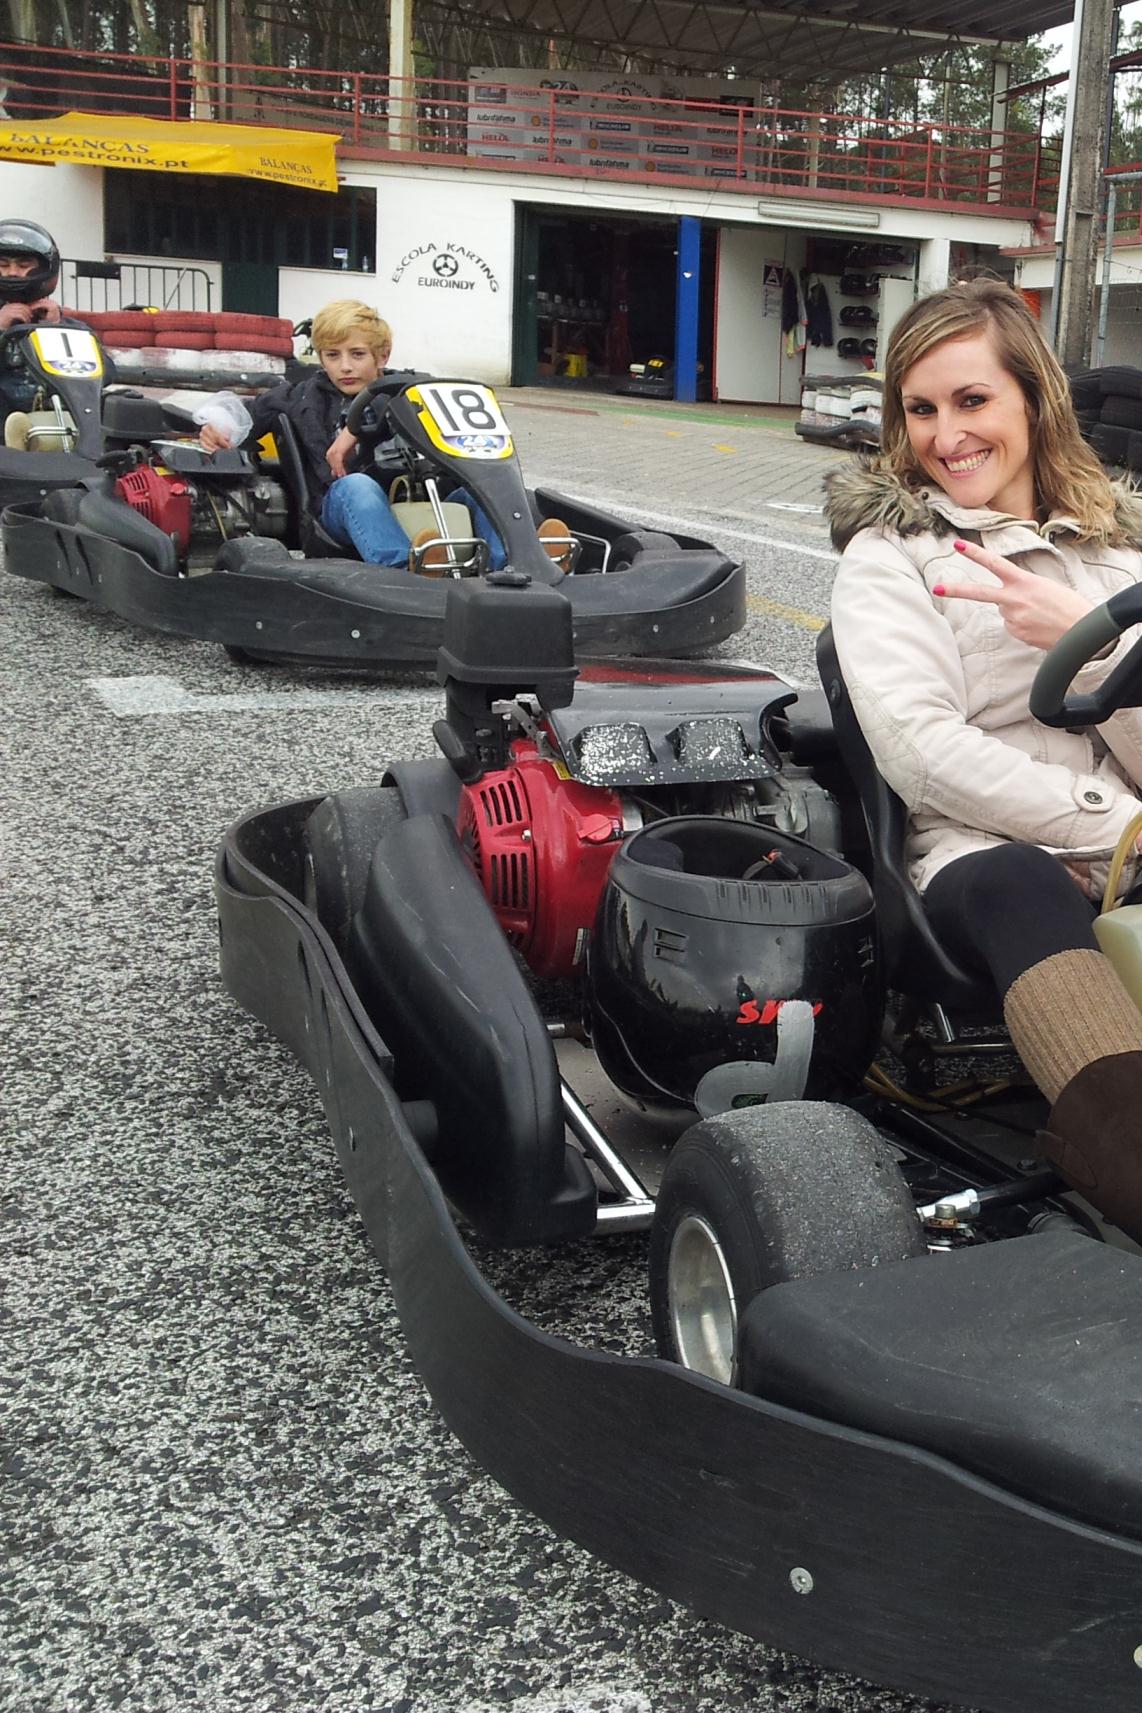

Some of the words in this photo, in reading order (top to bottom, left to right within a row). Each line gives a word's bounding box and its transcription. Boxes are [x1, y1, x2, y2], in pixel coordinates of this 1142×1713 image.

[391, 242, 437, 284] ESCOLA
[446, 242, 500, 293] KARTING
[417, 276, 476, 291] EUROINDY
[60, 332, 74, 358] 1
[428, 389, 497, 431] 18
